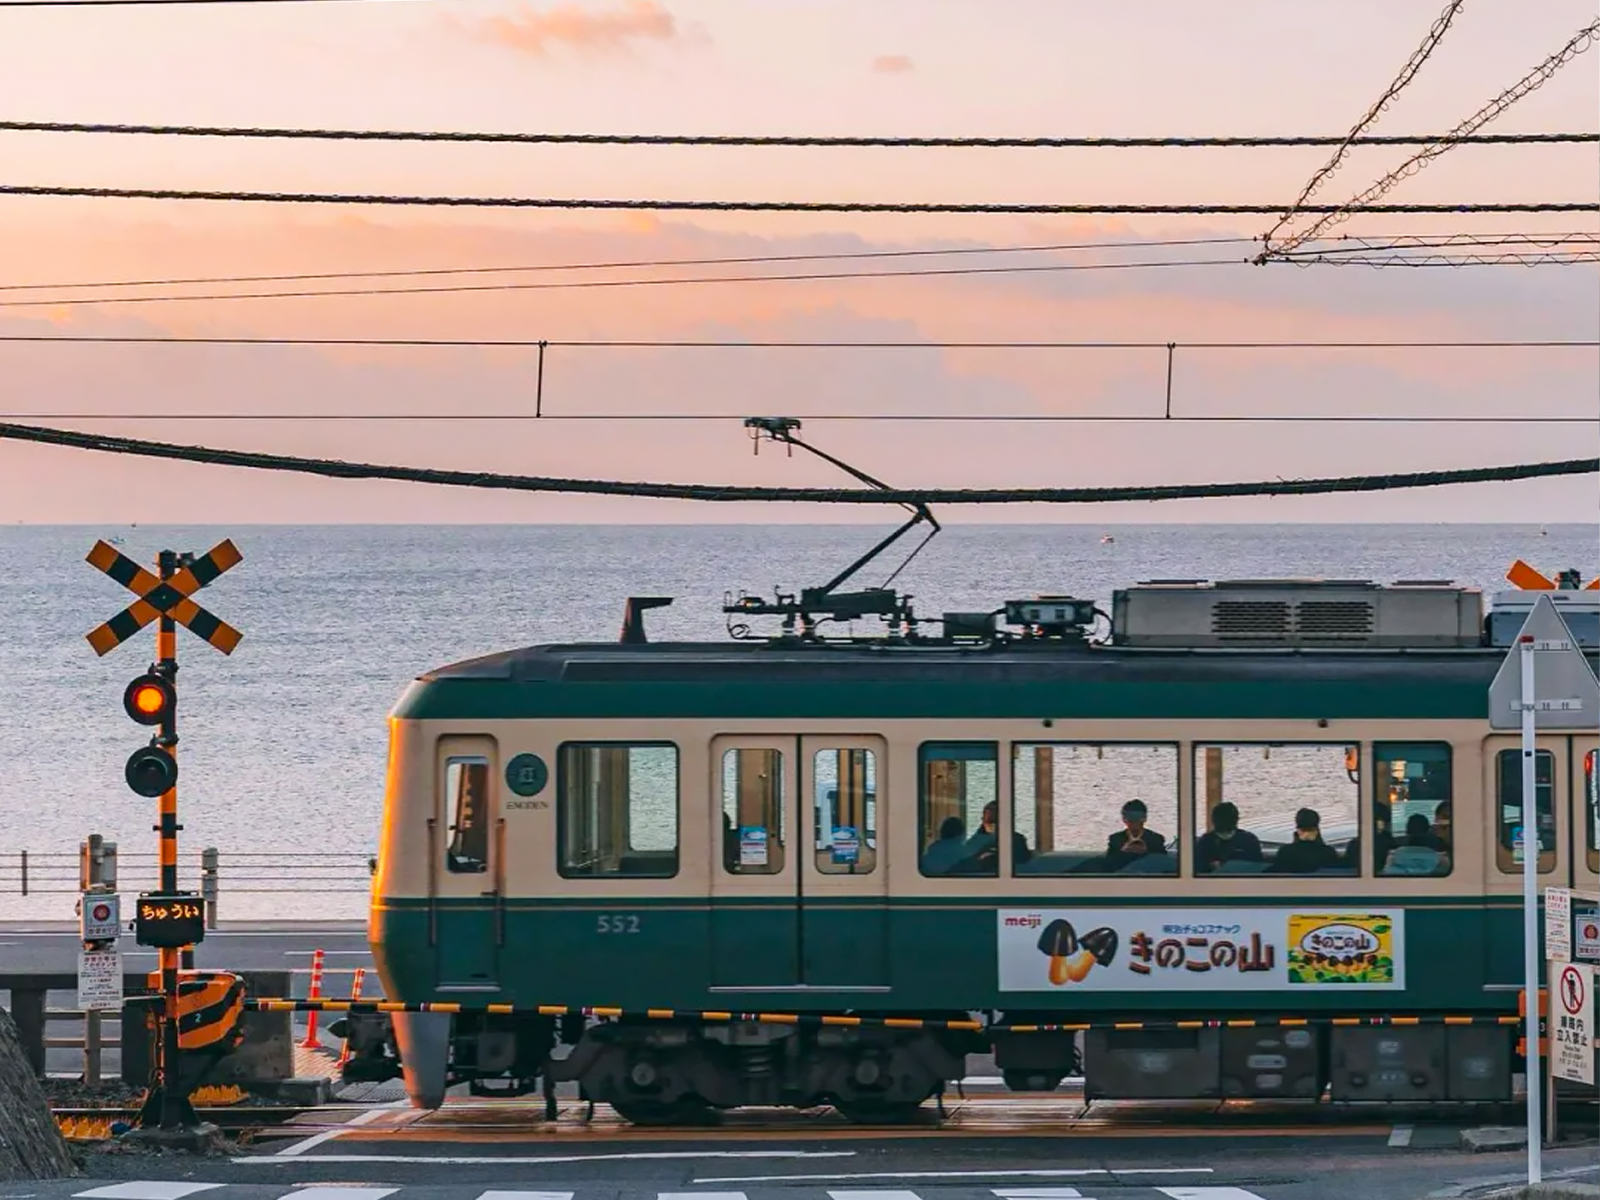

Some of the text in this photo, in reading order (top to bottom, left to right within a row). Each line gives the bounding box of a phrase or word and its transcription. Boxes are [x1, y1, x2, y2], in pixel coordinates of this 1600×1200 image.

[142, 904, 199, 919] ちゅうい
[597, 915, 640, 933] 552
[1005, 914, 1042, 928] meiji
[1311, 932, 1371, 951] きのこの山
[1128, 931, 1275, 975] きのこの山
[195, 1013, 201, 1023] 2
[1540, 1022, 1546, 1032] 3
